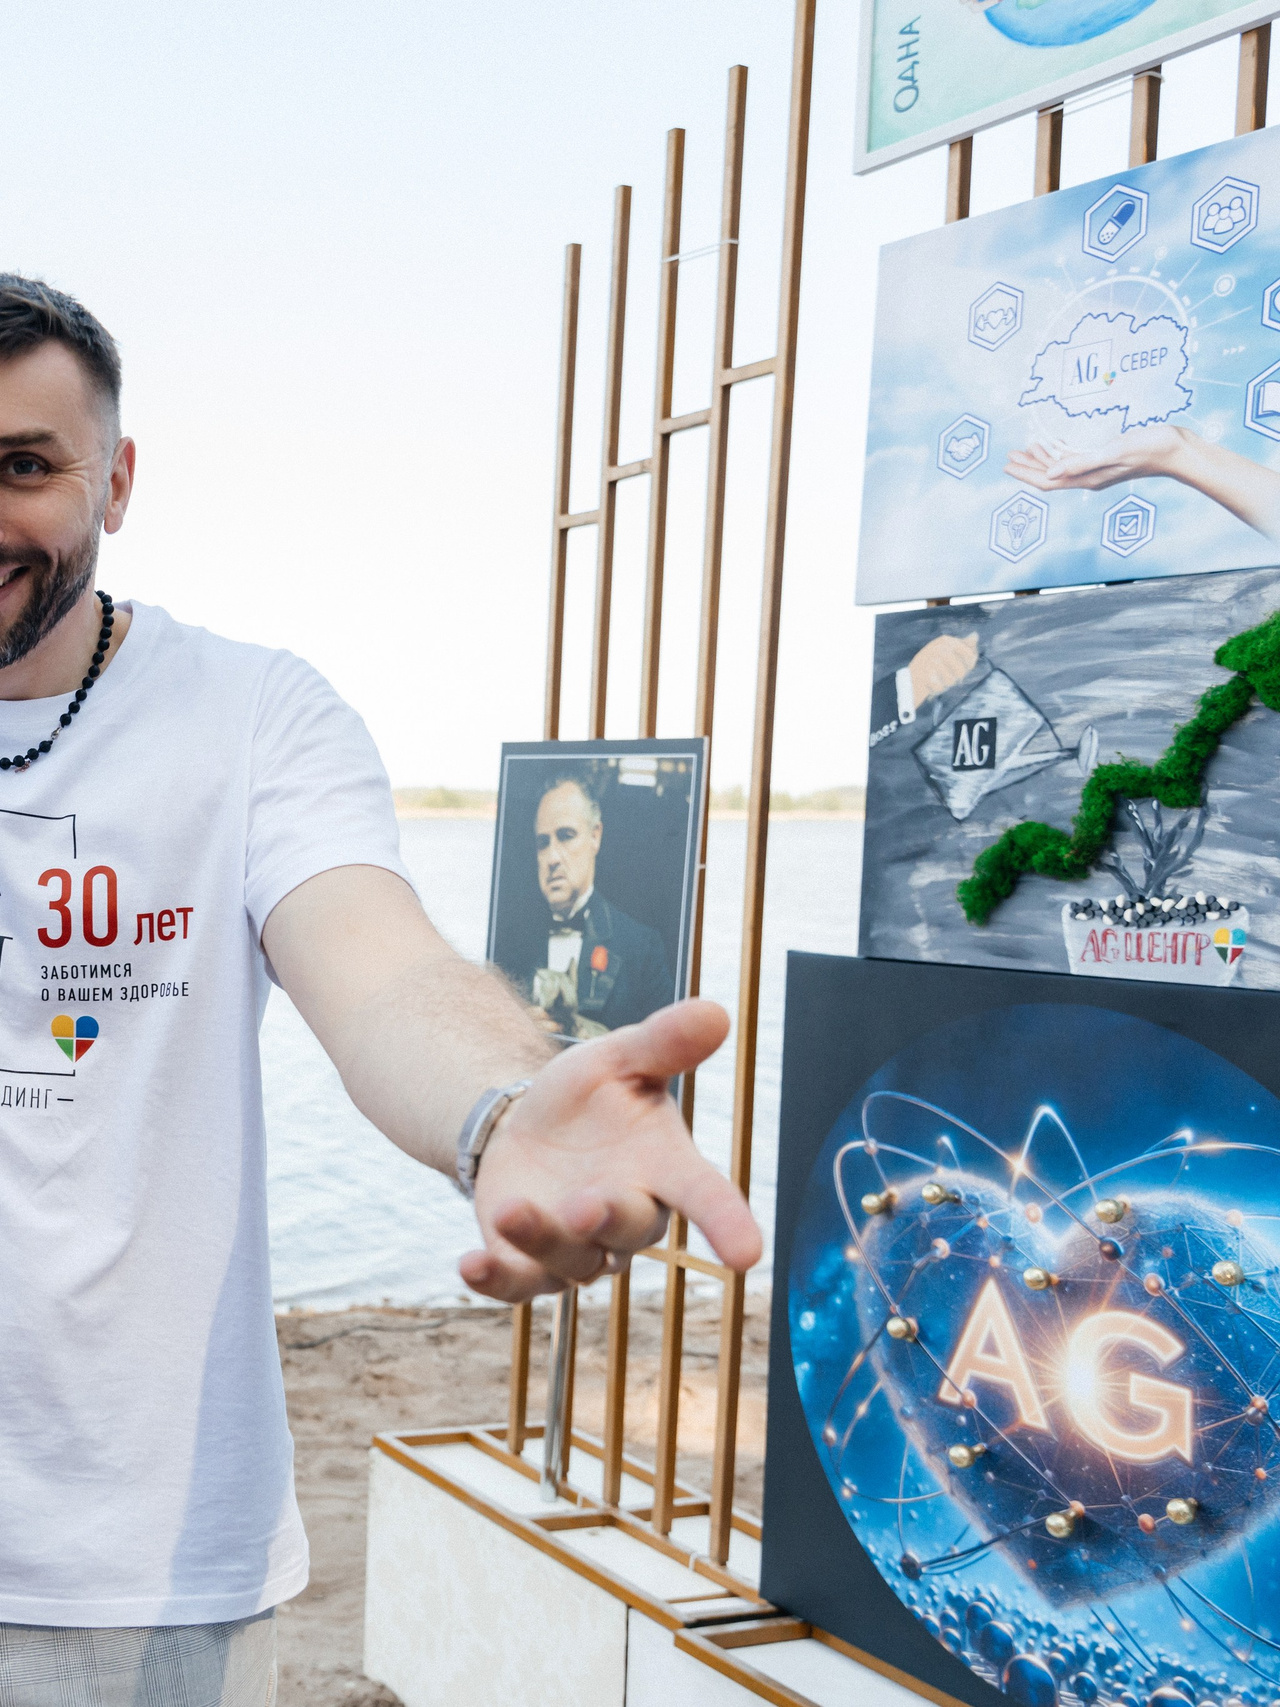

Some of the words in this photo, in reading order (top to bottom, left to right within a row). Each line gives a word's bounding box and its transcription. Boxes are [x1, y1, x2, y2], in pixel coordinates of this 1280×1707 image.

[893, 14, 921, 114] ОДНА
[1068, 352, 1099, 386] AG
[1119, 346, 1168, 373] СЕВЕР
[952, 721, 990, 767] AG
[37, 865, 118, 949] 30
[133, 907, 194, 946] лет
[1080, 928, 1120, 964] AG
[1124, 931, 1211, 966] ЦЕНТР
[40, 962, 133, 980] ЗАБОТИМСЯ
[40, 987, 50, 1002] О
[58, 987, 113, 1002] ВАШЕМ
[120, 981, 190, 1003] ЗДОРОВЬЕ
[937, 1276, 1194, 1468] AG
